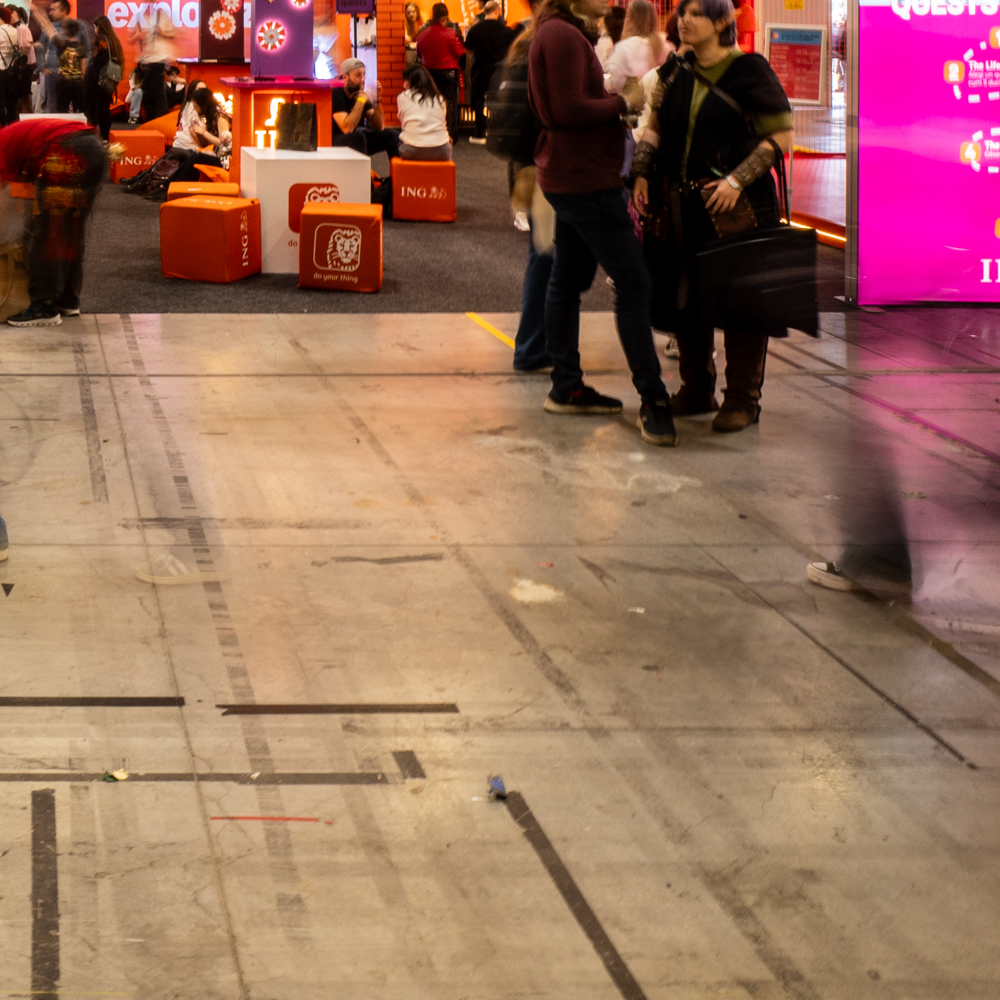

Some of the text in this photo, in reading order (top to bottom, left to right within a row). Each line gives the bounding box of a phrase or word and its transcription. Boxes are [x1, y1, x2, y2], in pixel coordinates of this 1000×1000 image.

[340, 0, 367, 8] quests
[968, 60, 983, 71] The
[964, 143, 976, 160] 4
[120, 156, 142, 166] ING
[401, 186, 427, 198] ING
[287, 239, 298, 247] do
[241, 235, 249, 266] ING
[340, 274, 358, 284] thing
